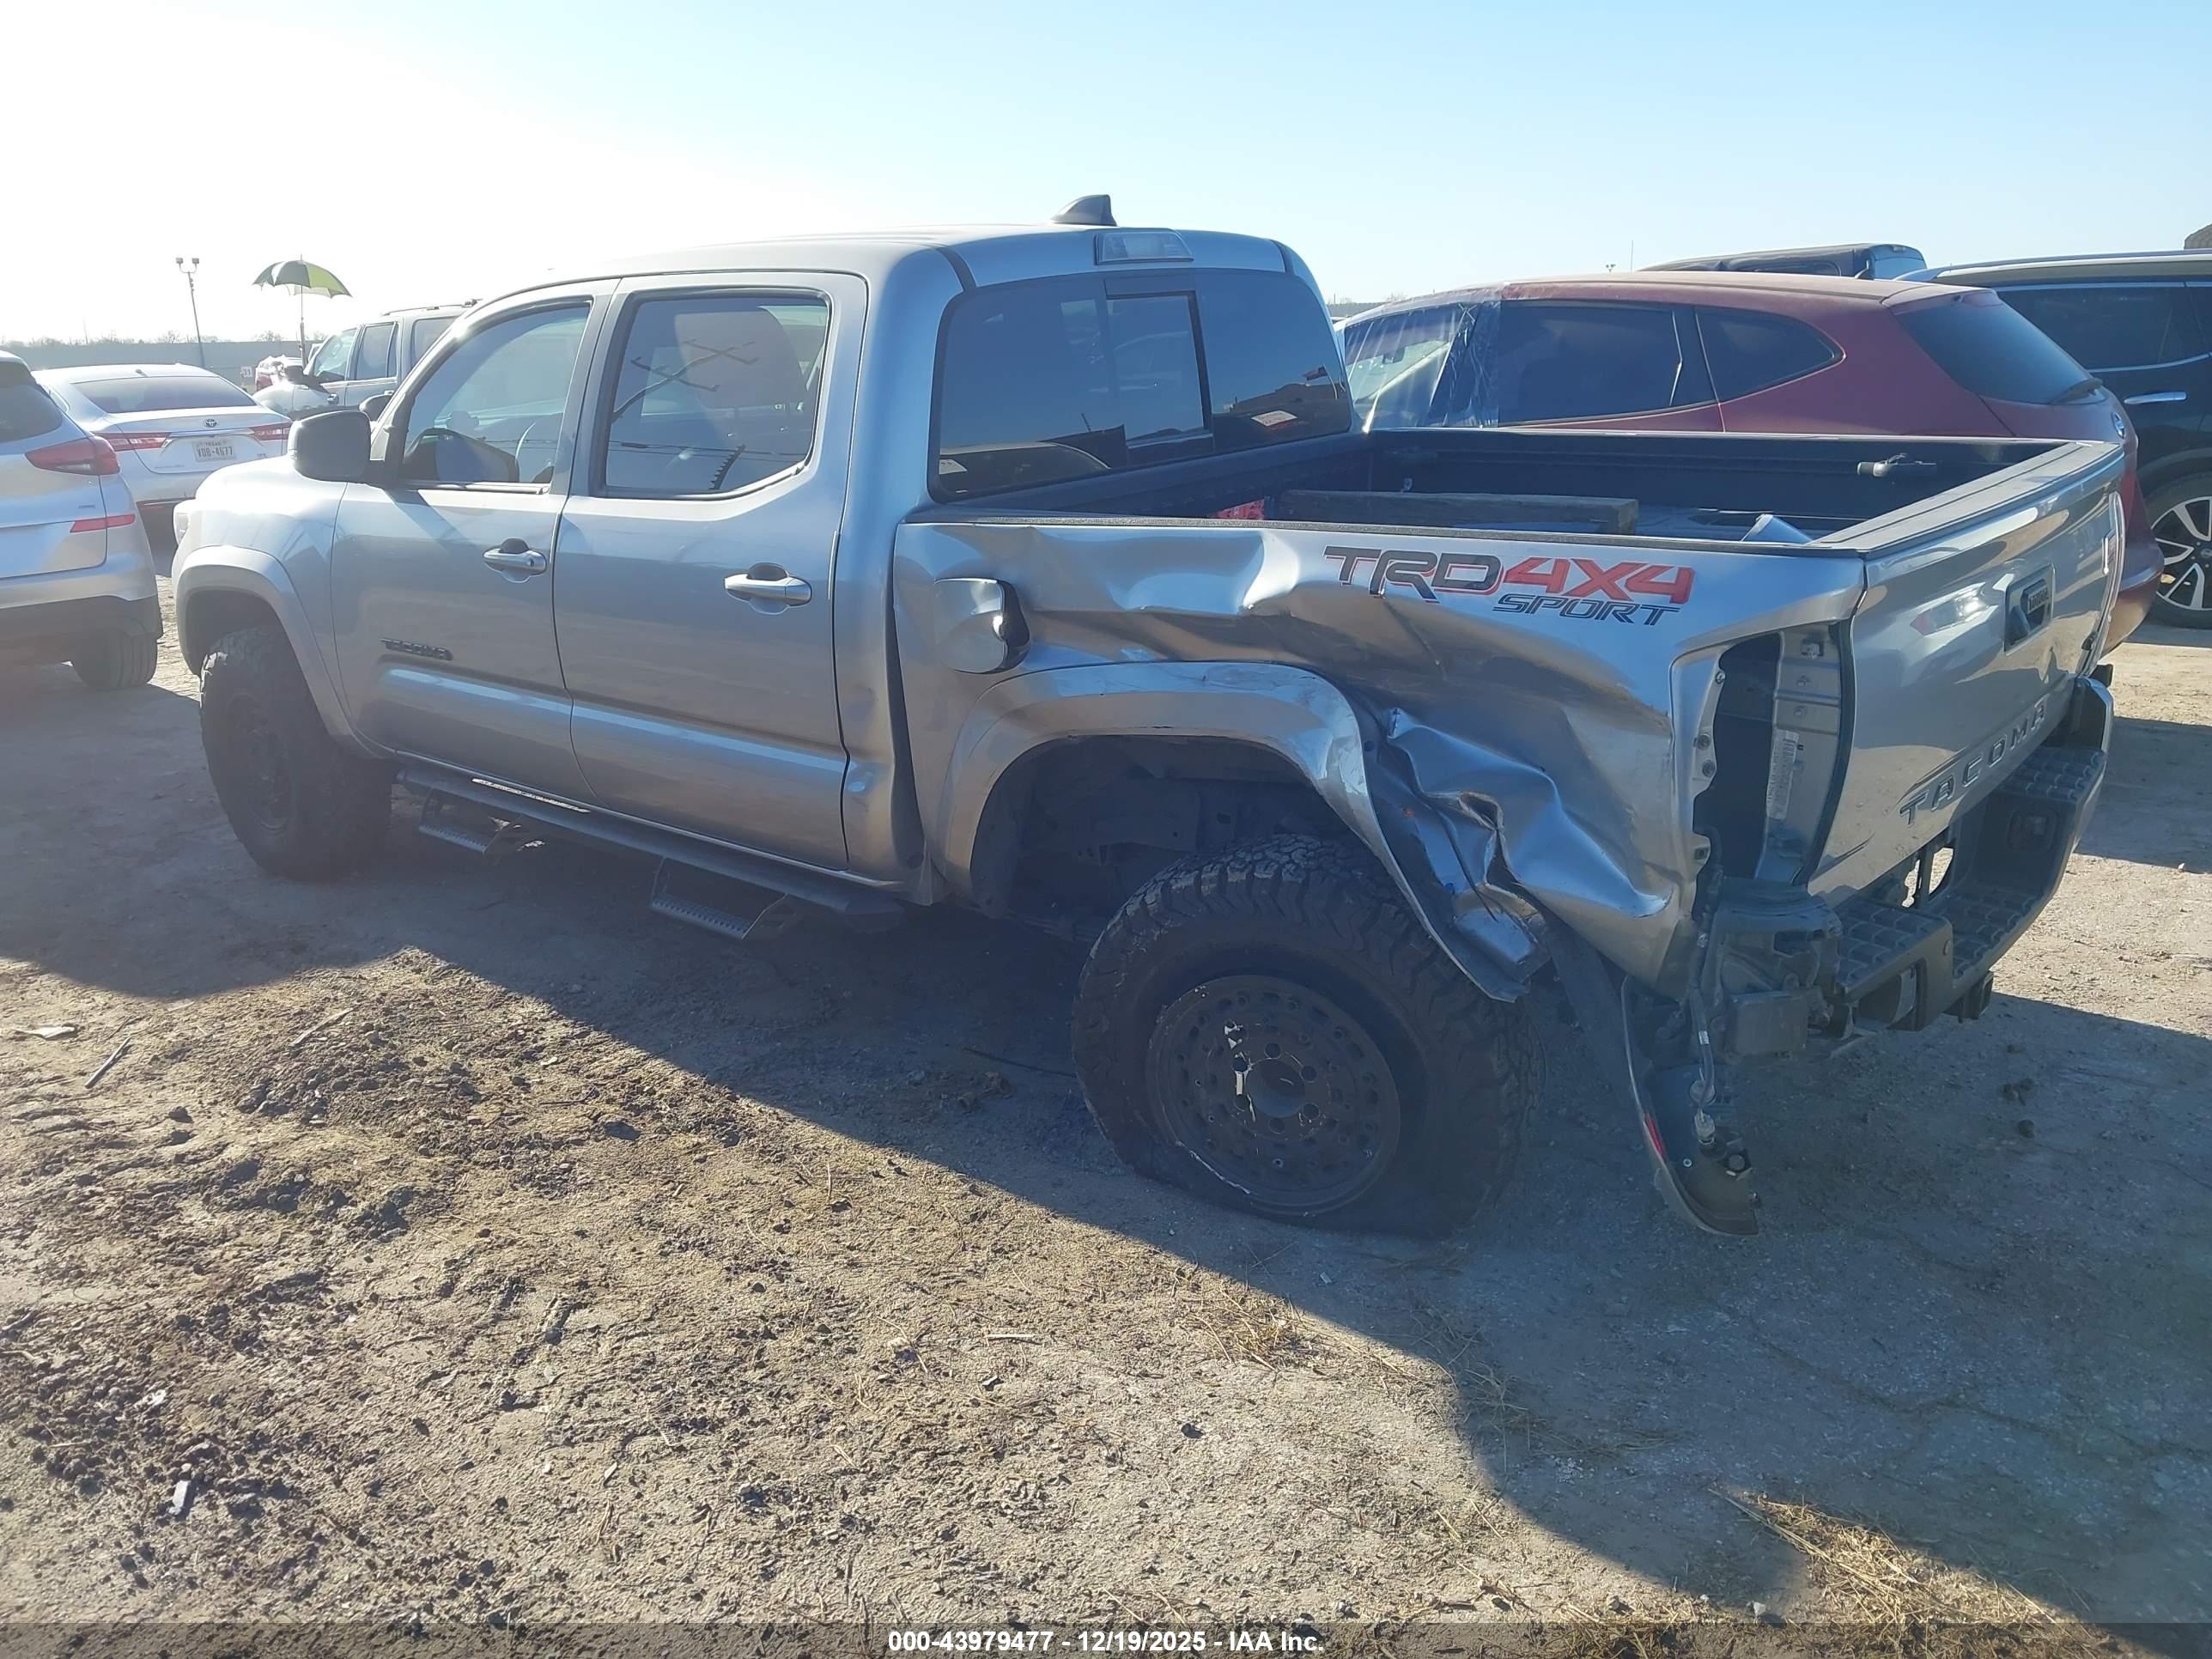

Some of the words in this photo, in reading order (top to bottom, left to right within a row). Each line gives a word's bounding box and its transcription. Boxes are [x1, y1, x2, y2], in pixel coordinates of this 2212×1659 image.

[1323, 544, 1504, 604] TRD
[1492, 593, 1680, 626] SPORT
[1899, 696, 2048, 825] TACOMA
